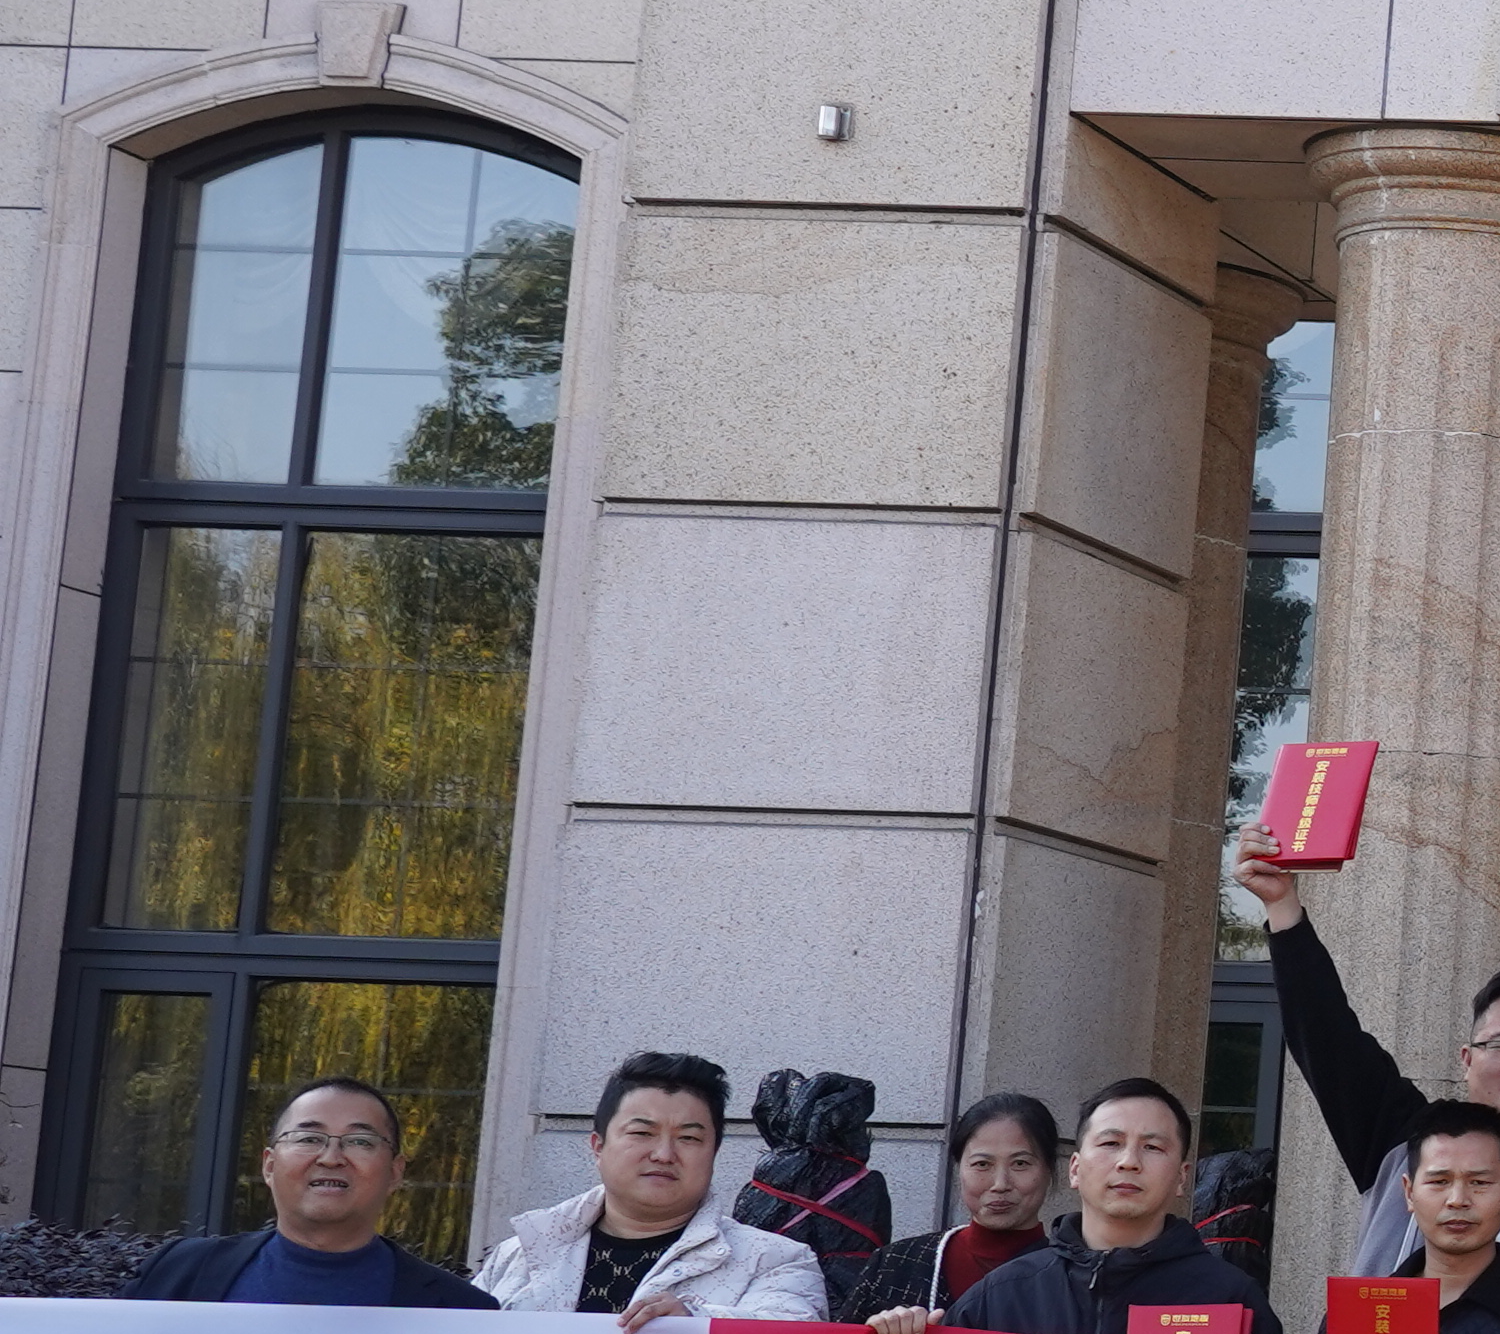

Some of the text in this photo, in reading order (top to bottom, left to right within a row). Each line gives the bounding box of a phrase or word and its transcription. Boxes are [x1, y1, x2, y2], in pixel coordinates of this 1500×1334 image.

[1290, 760, 1330, 853] 安装技师等级证书
